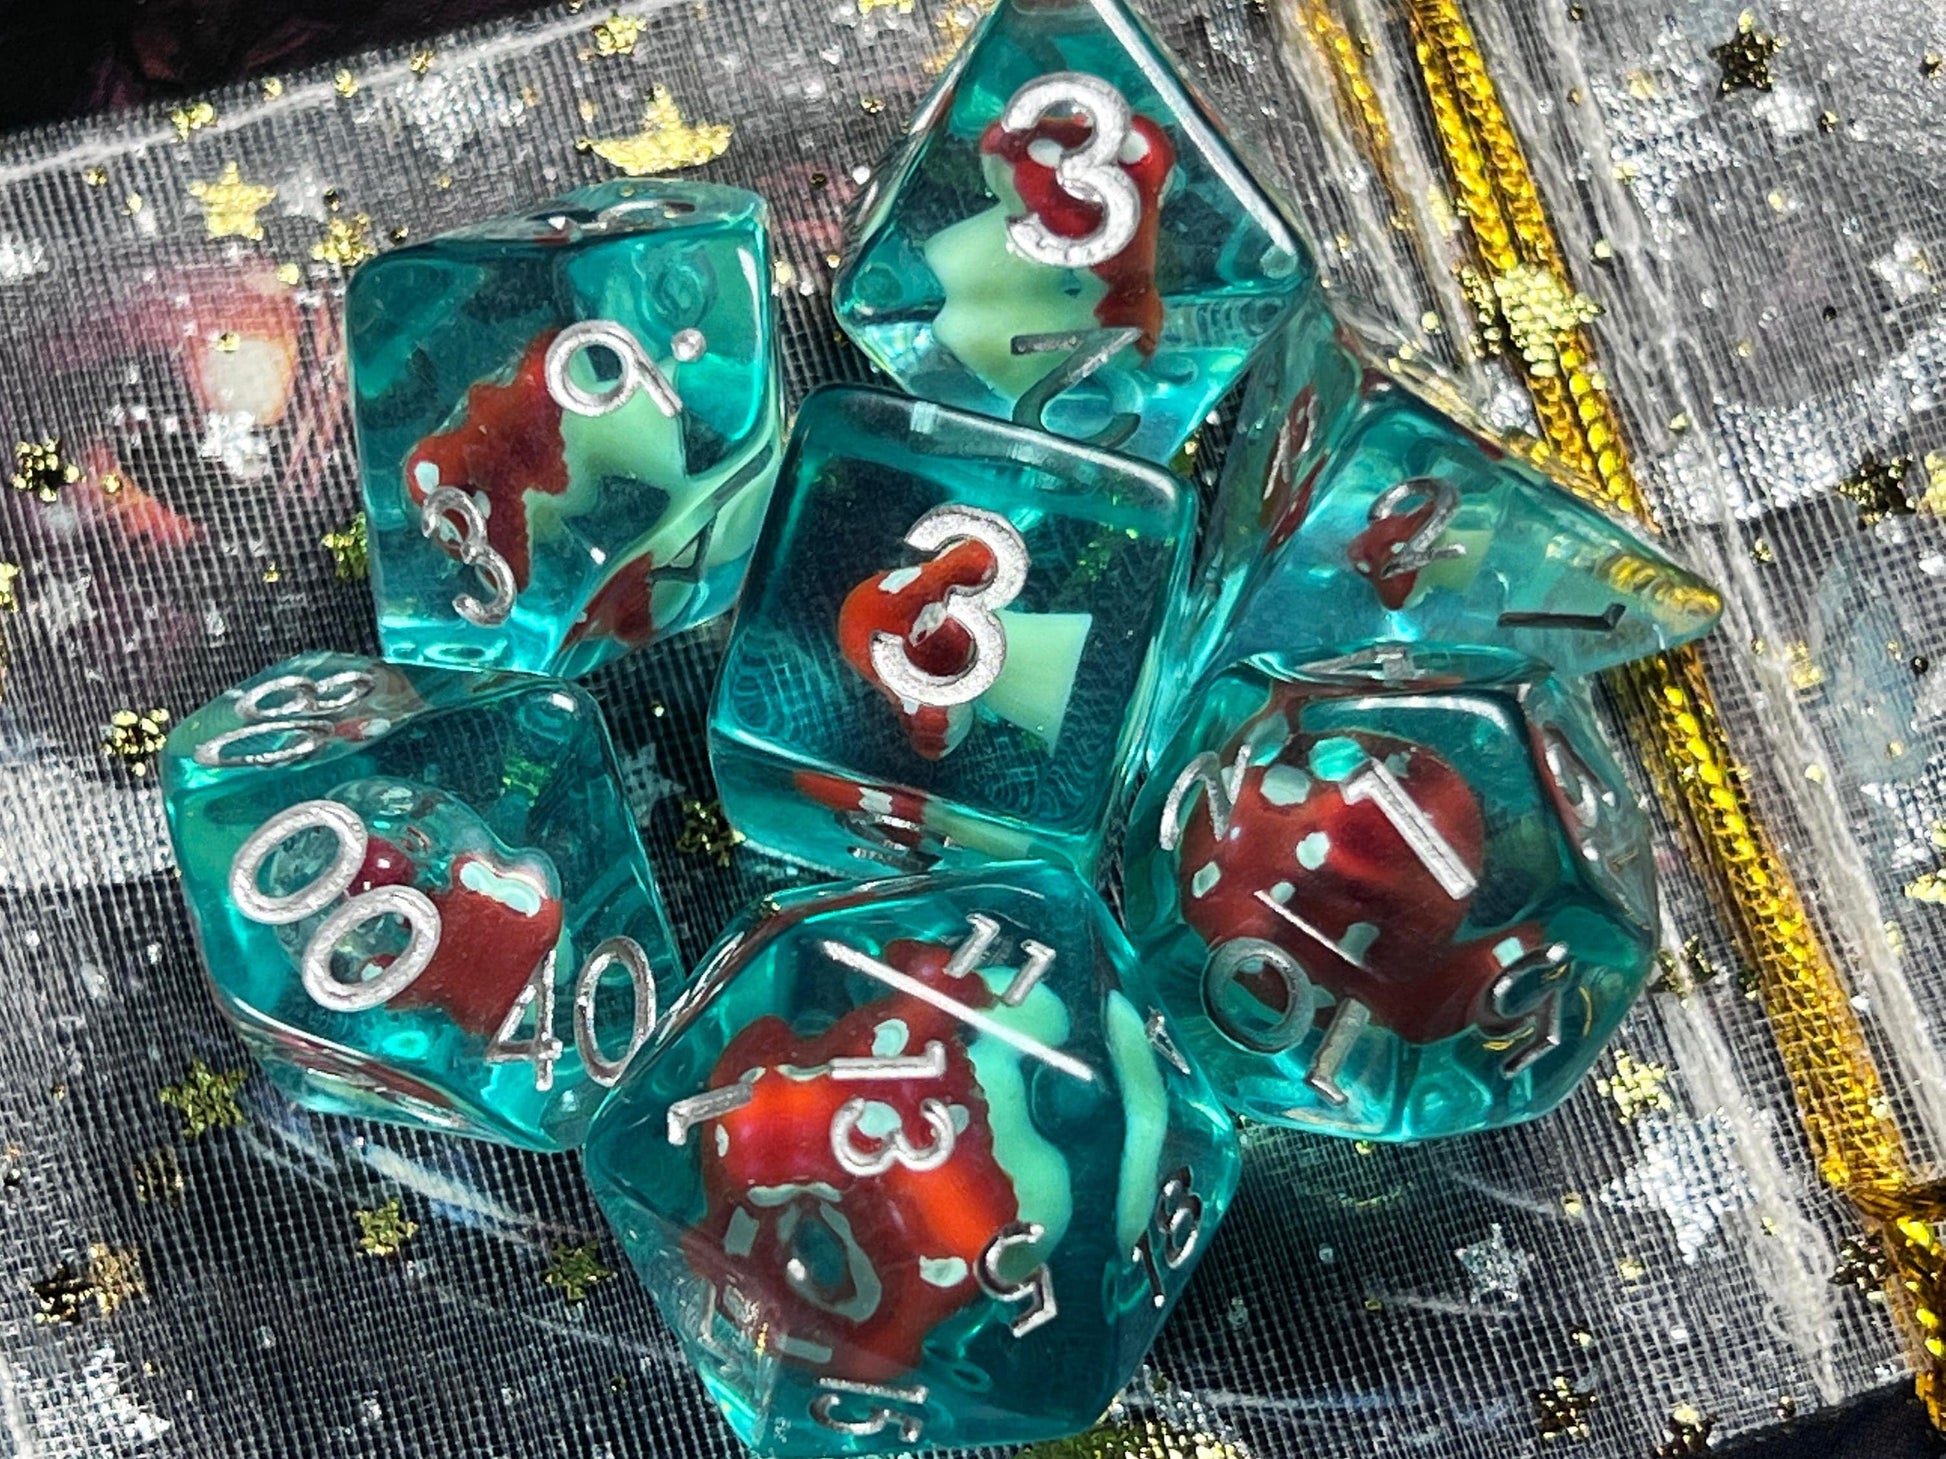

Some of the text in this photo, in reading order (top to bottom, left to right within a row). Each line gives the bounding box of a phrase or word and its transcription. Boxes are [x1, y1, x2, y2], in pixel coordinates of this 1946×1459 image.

[1001, 72, 1141, 267] 3
[421, 486, 517, 626] 3
[1367, 476, 1467, 579] 2
[870, 503, 1031, 706] 3
[1340, 756, 1478, 900] 1
[229, 799, 442, 1013] 00
[485, 936, 656, 1092] 40
[830, 1040, 956, 1177] 13
[974, 1222, 1058, 1338] 5
[807, 1376, 930, 1443] 15
